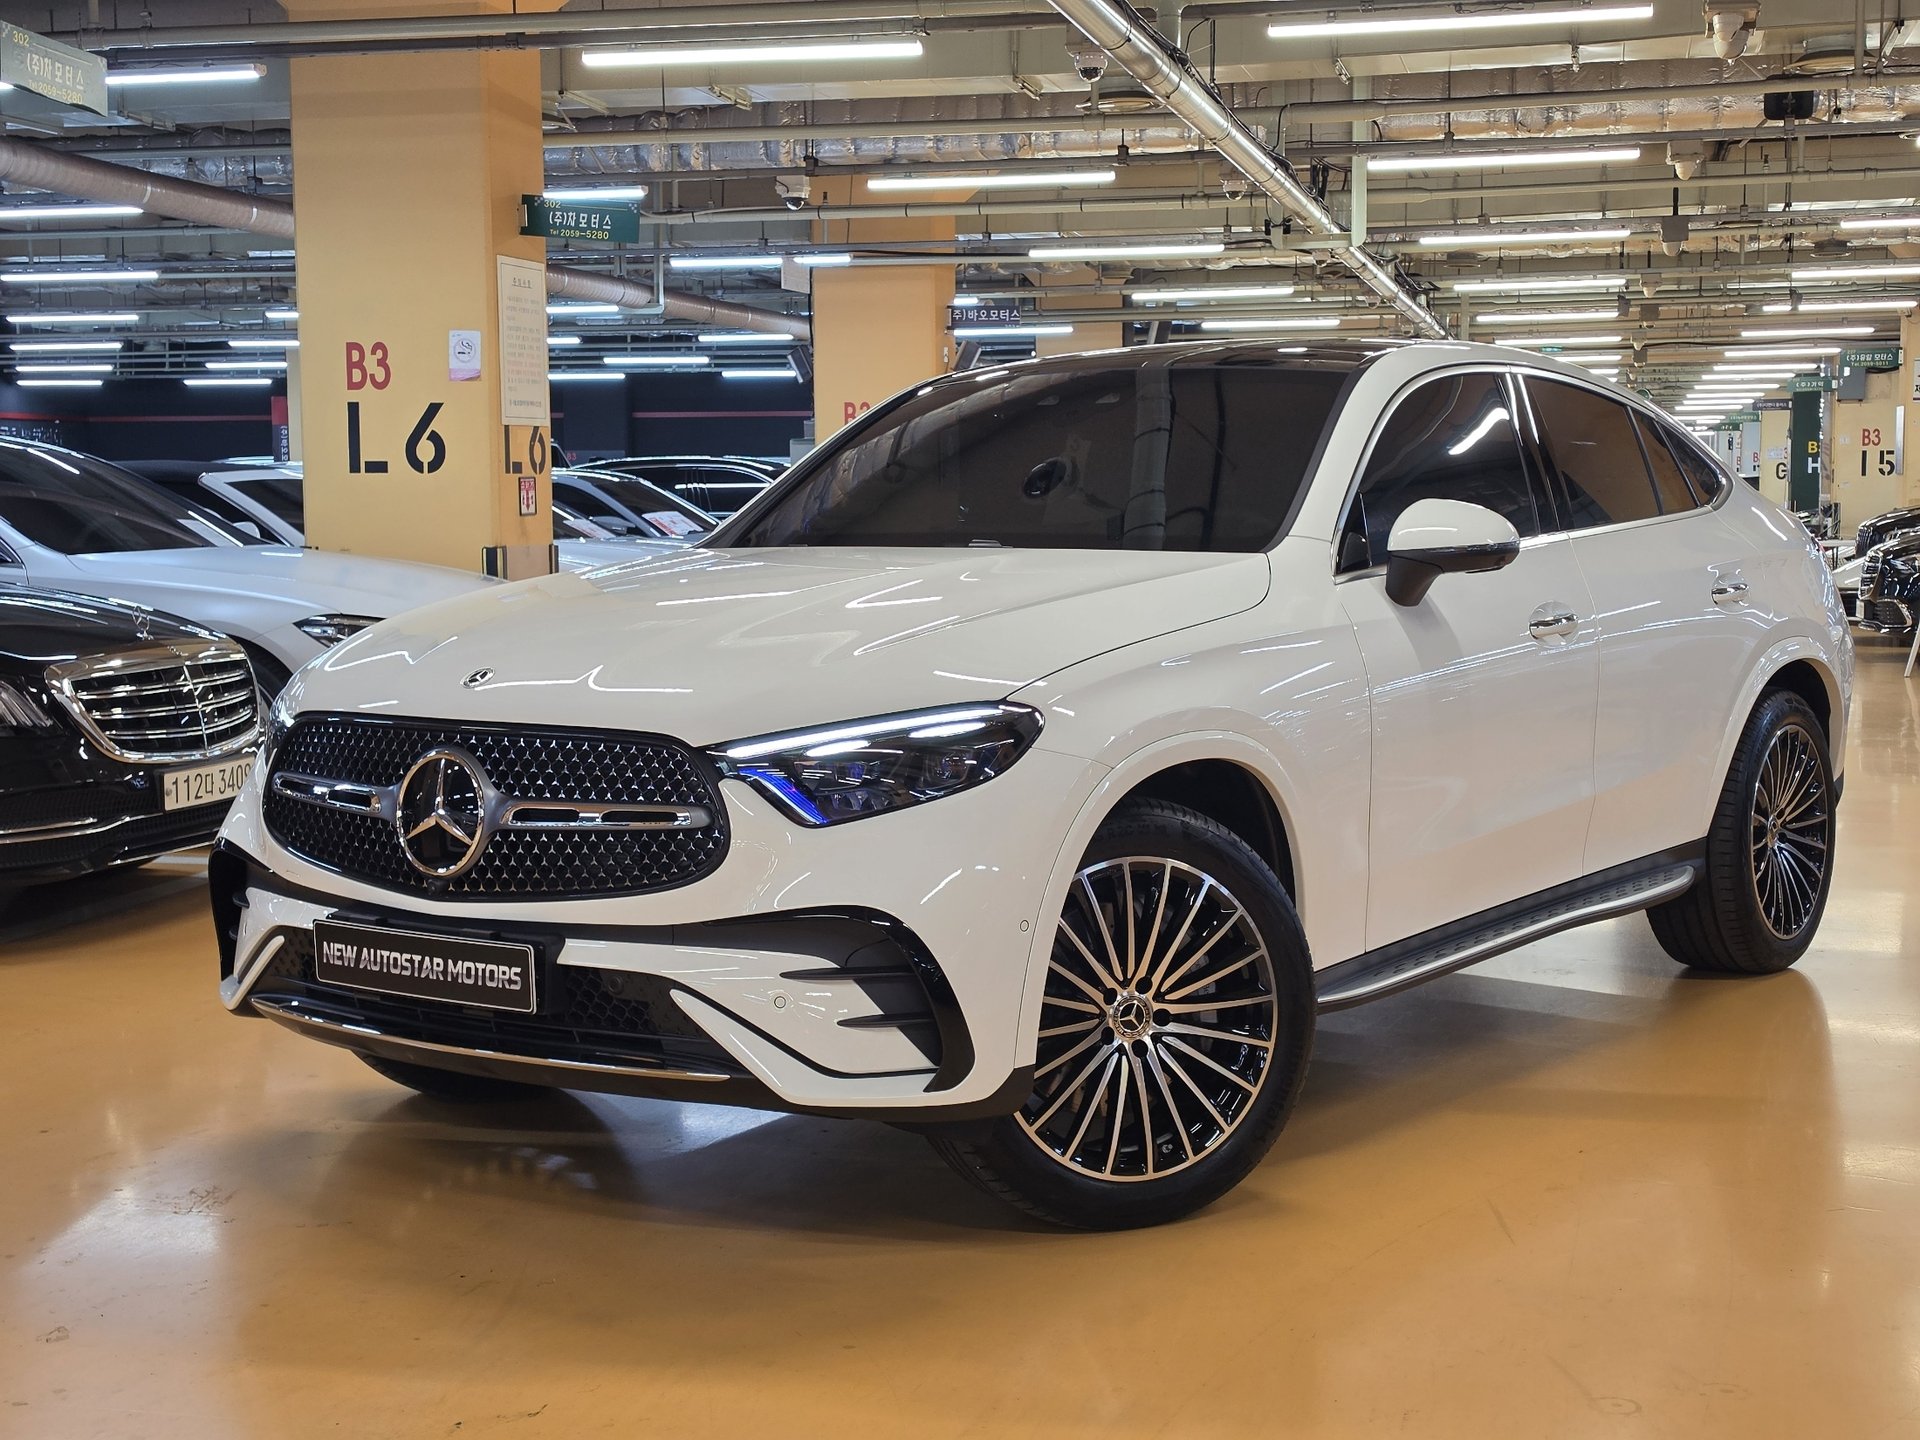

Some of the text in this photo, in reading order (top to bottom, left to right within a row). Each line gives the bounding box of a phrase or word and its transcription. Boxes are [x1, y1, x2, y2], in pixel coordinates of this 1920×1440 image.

[12, 30, 30, 47] 302
[27, 52, 84, 90] (주)차모터스
[39, 82, 83, 104] 2059-5280
[543, 200, 561, 208] 302
[549, 211, 612, 229] (주)차모터스
[560, 229, 609, 240] 2059-5280
[345, 341, 392, 391] B3
[1861, 428, 1881, 447] B3
[1807, 441, 1821, 454] B
[566, 452, 577, 462] B3
[171, 772, 215, 804] 112다
[322, 941, 522, 991] NEW AUTOSTAR MOTORS
